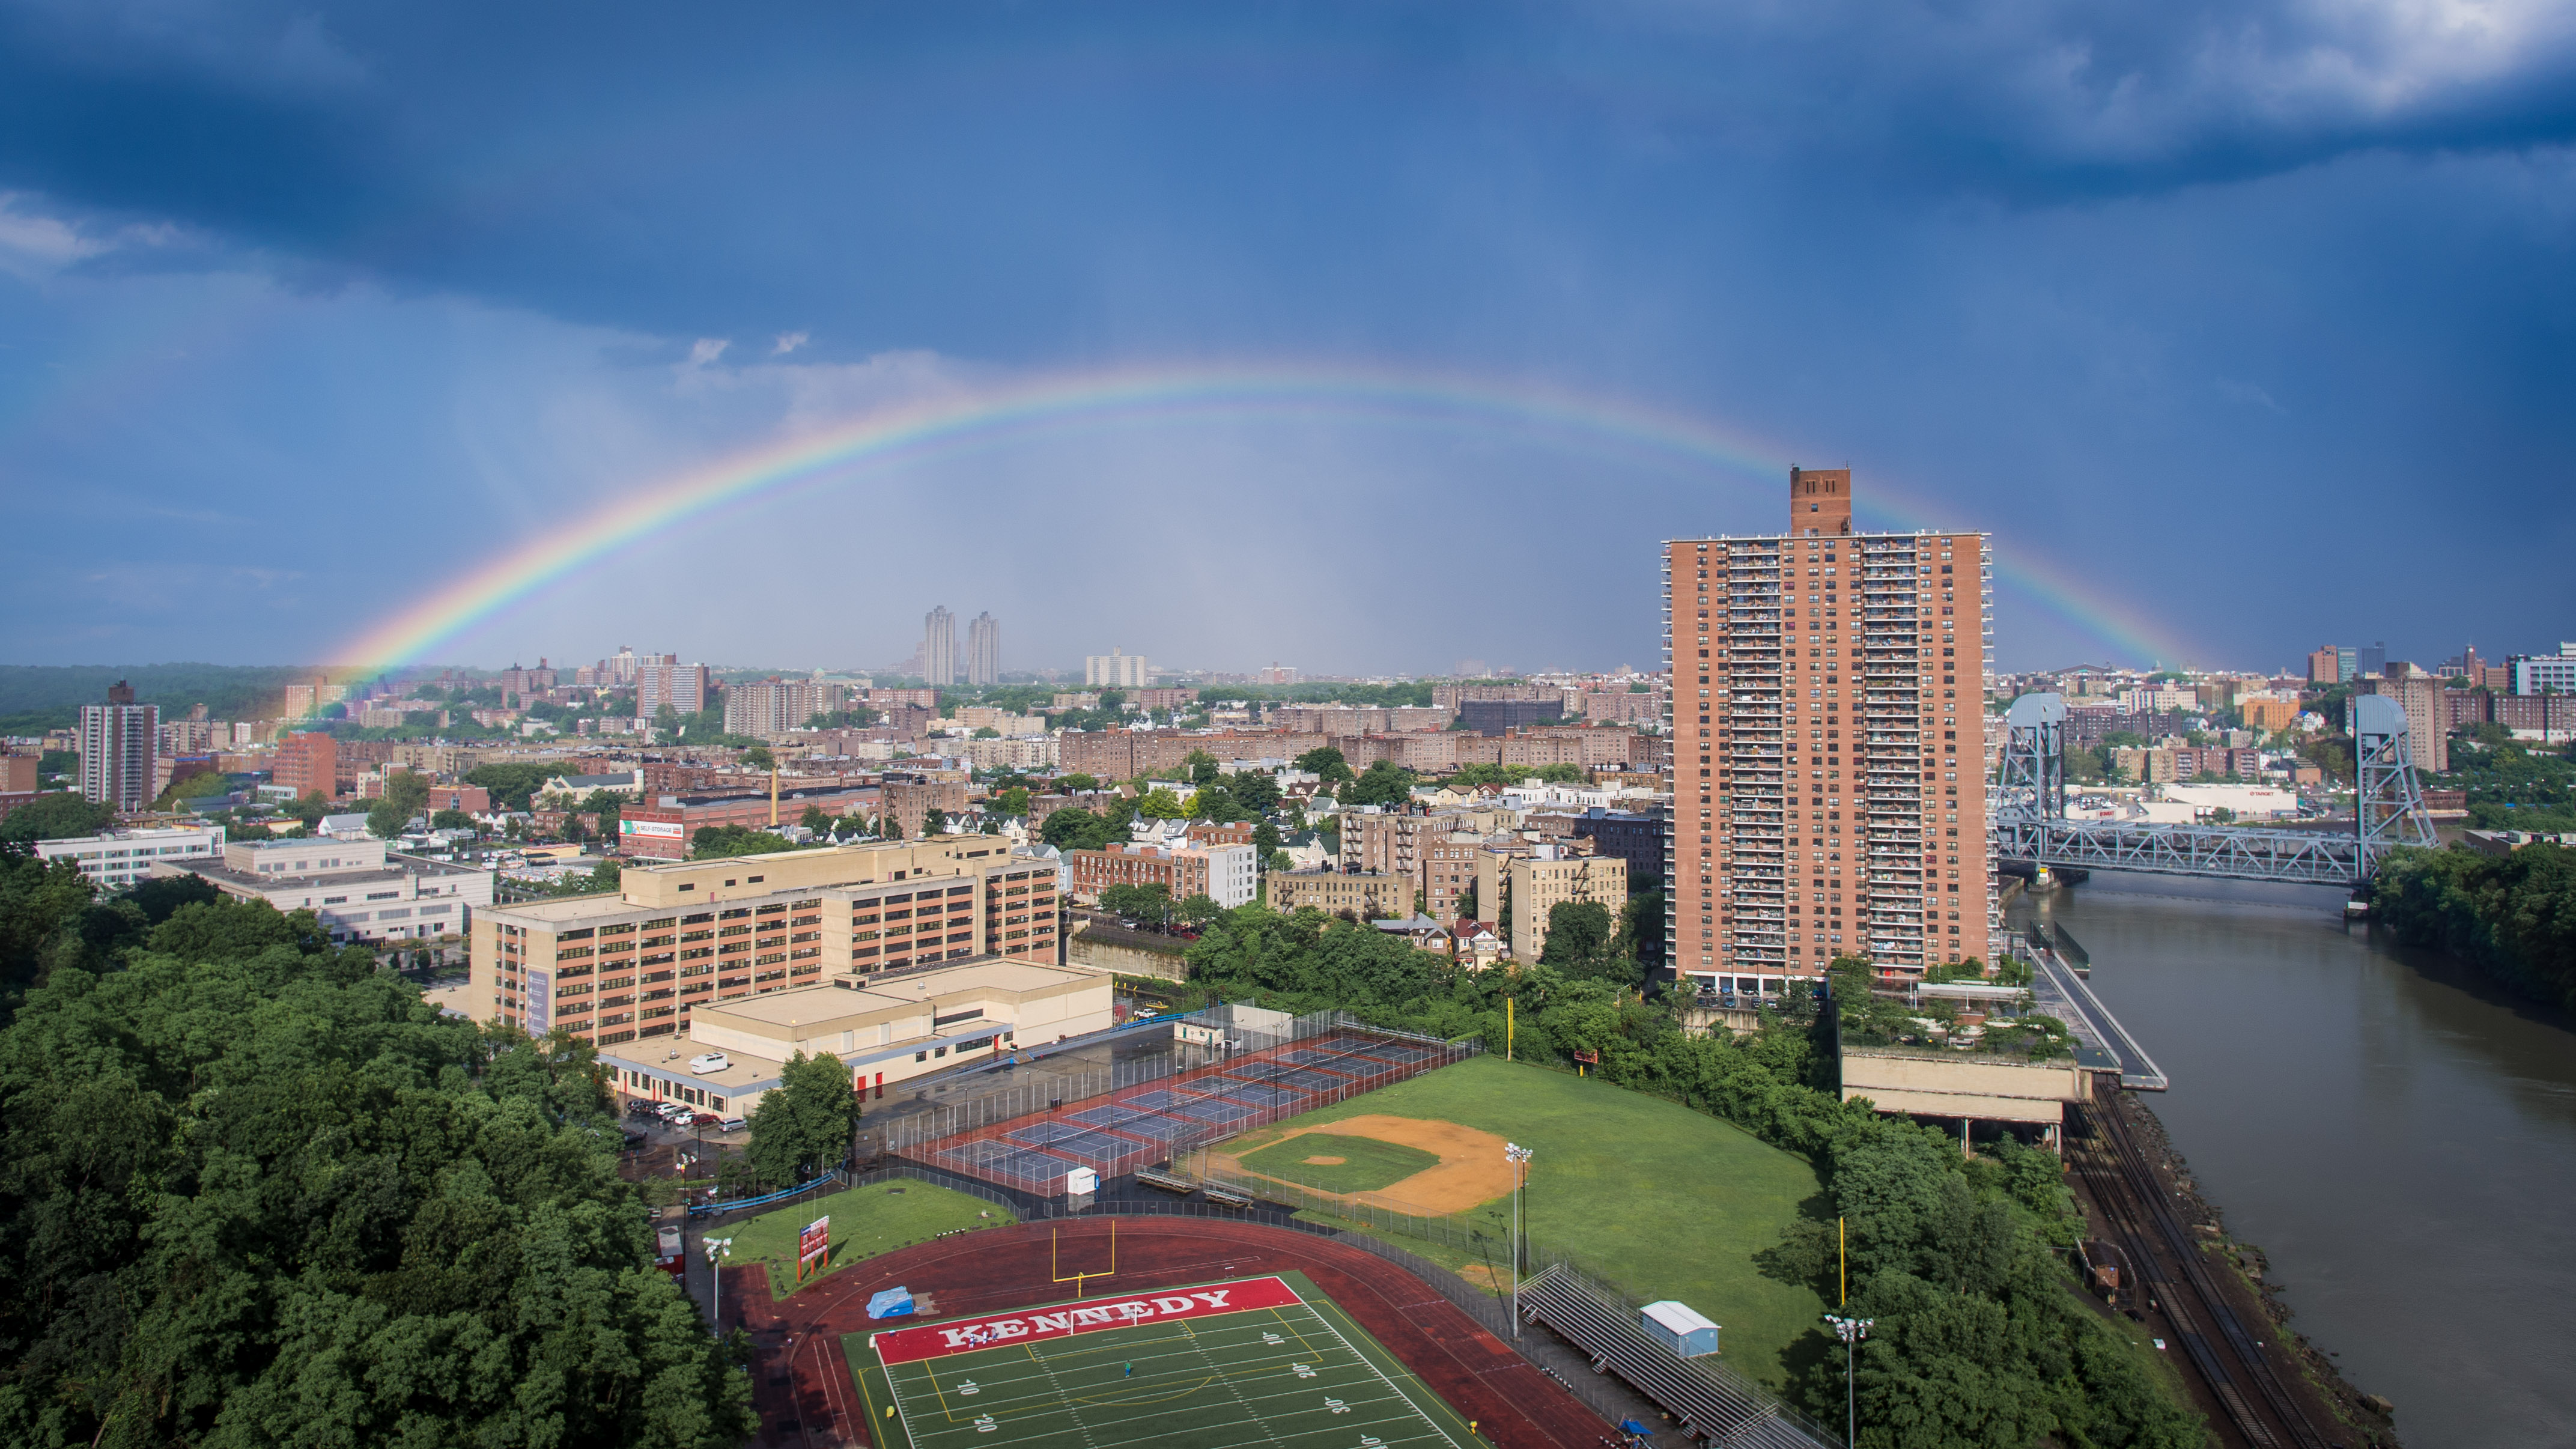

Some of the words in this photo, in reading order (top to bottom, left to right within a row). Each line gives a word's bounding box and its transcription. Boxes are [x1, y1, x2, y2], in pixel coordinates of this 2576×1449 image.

[938, 1289, 1230, 1347] KENNEDY
[1262, 1334, 1285, 1345] 10
[1292, 1364, 1317, 1378] 20
[957, 1382, 980, 1395] 10
[1325, 1399, 1350, 1414] 30
[974, 1417, 998, 1432] 20
